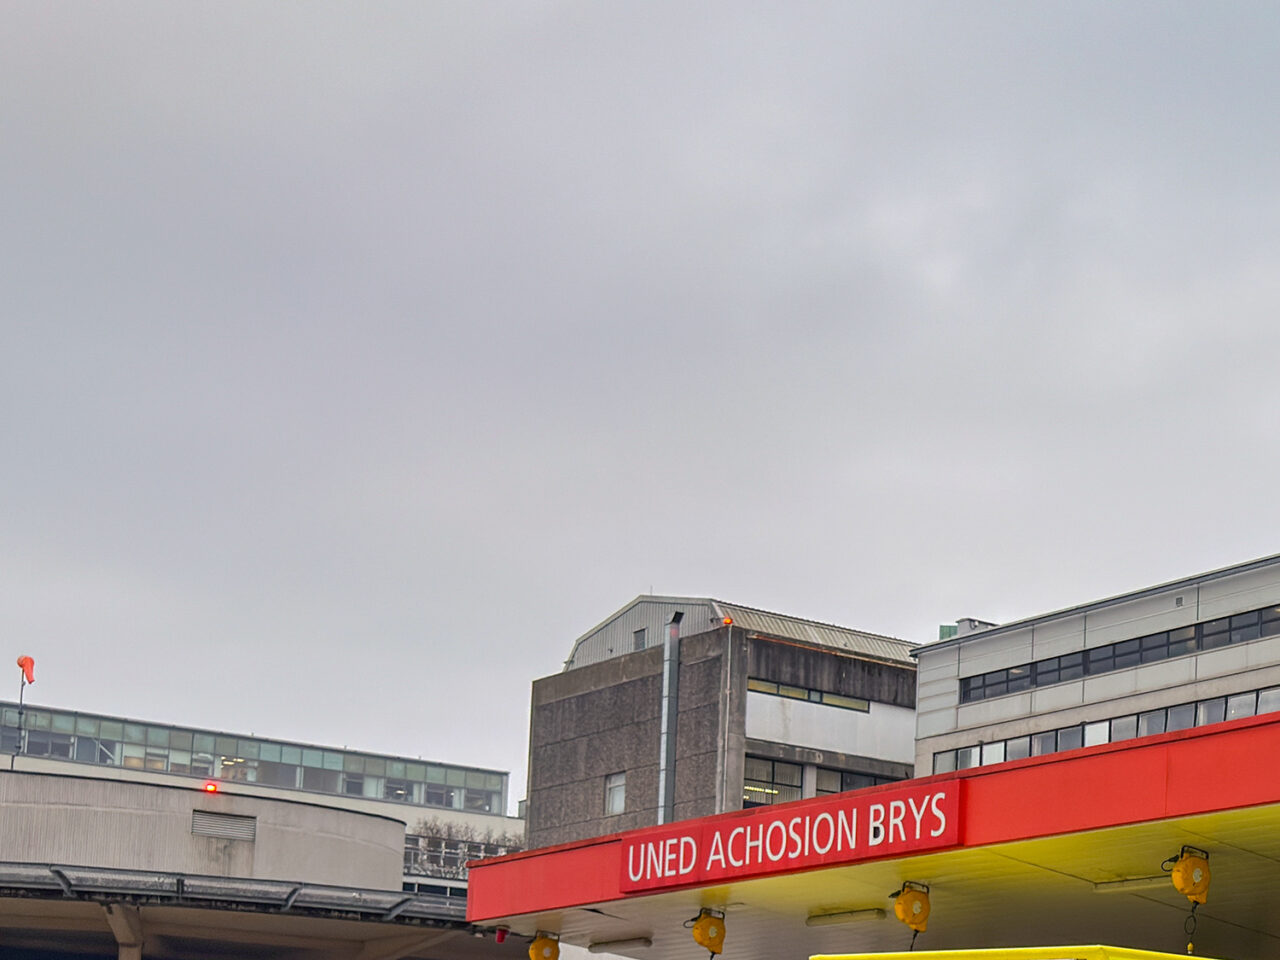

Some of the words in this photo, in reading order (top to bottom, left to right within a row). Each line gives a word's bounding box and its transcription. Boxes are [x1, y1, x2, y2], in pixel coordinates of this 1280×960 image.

[628, 836, 697, 882] UNED
[706, 808, 857, 871] ACHOSION
[868, 792, 947, 847] BRYS
